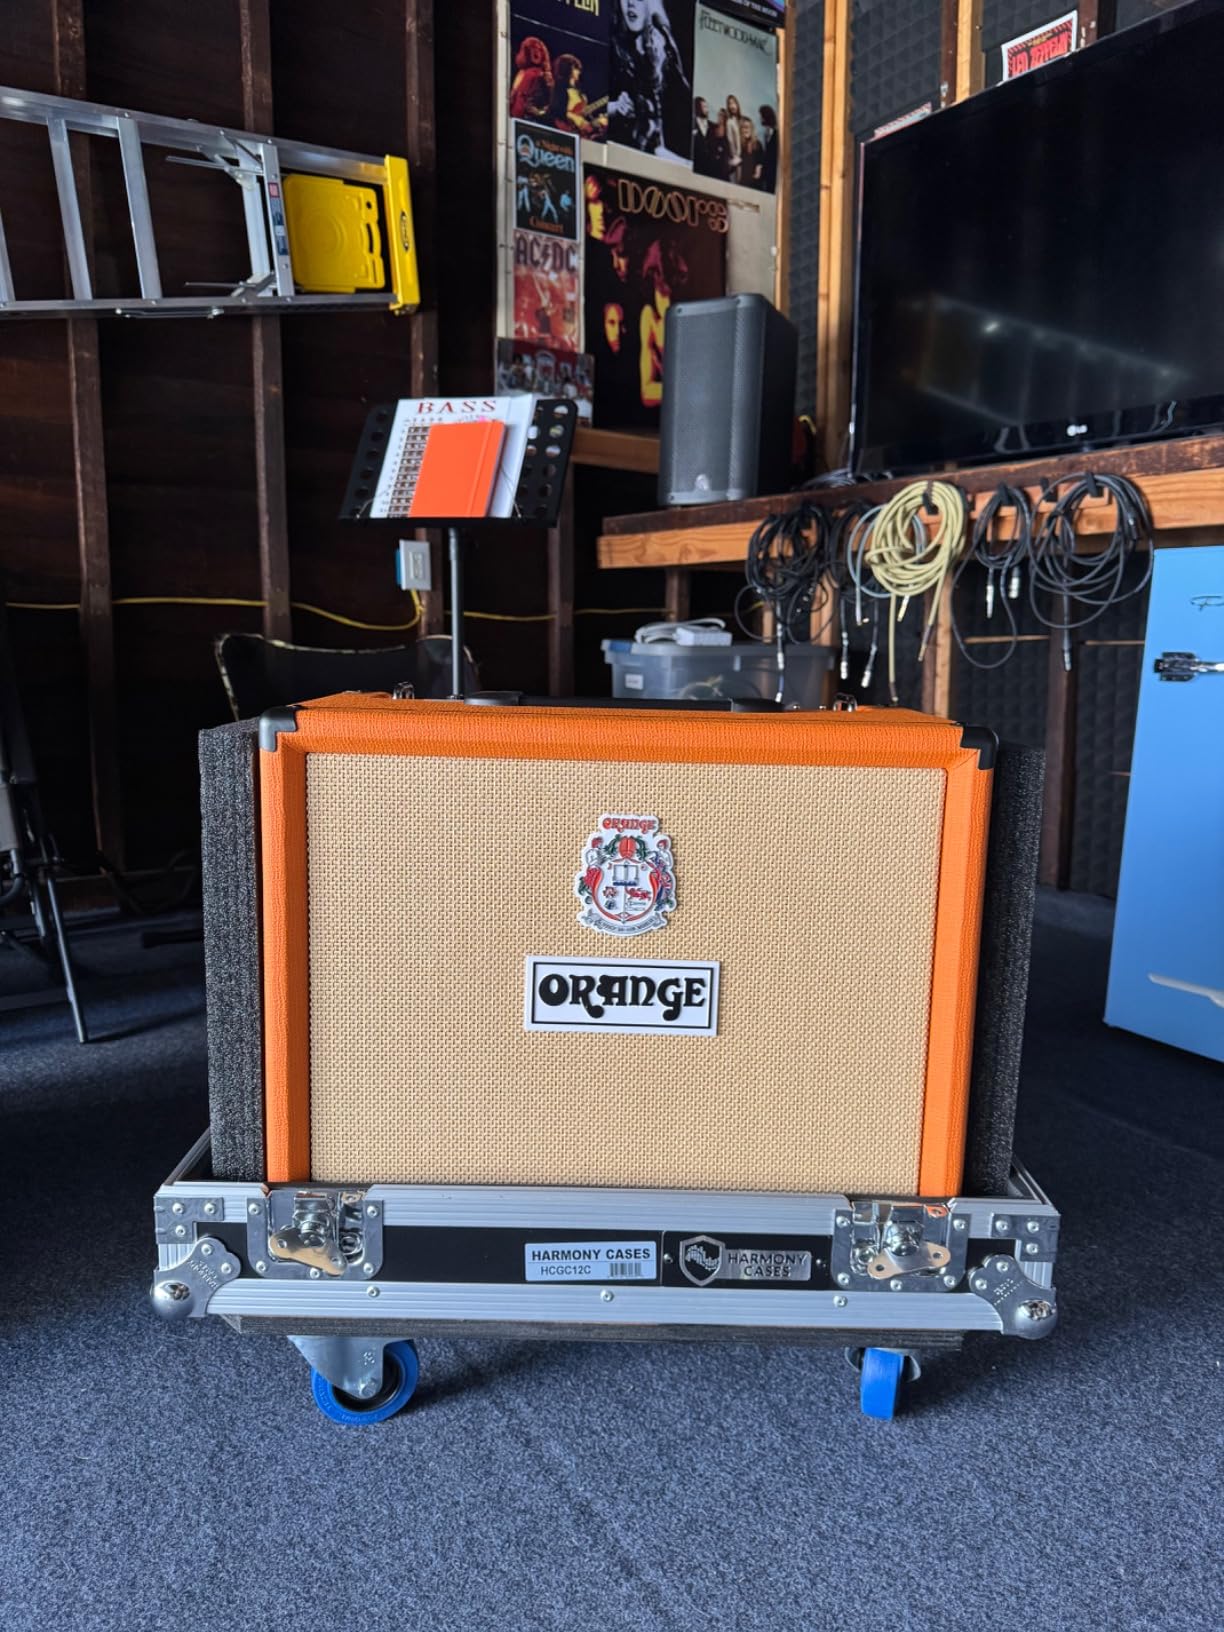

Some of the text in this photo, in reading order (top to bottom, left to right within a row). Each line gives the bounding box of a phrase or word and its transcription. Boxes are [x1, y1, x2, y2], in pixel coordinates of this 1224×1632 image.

[517, 134, 575, 173] Queen
[418, 401, 497, 413] BASS
[602, 817, 656, 834] ORANGE
[538, 973, 706, 1021] ORANGE
[531, 1248, 650, 1261] HARMONY CASES
[728, 1253, 807, 1265] HARMONY
[540, 1265, 592, 1276] HCGC12C
[744, 1266, 790, 1277] CASES
